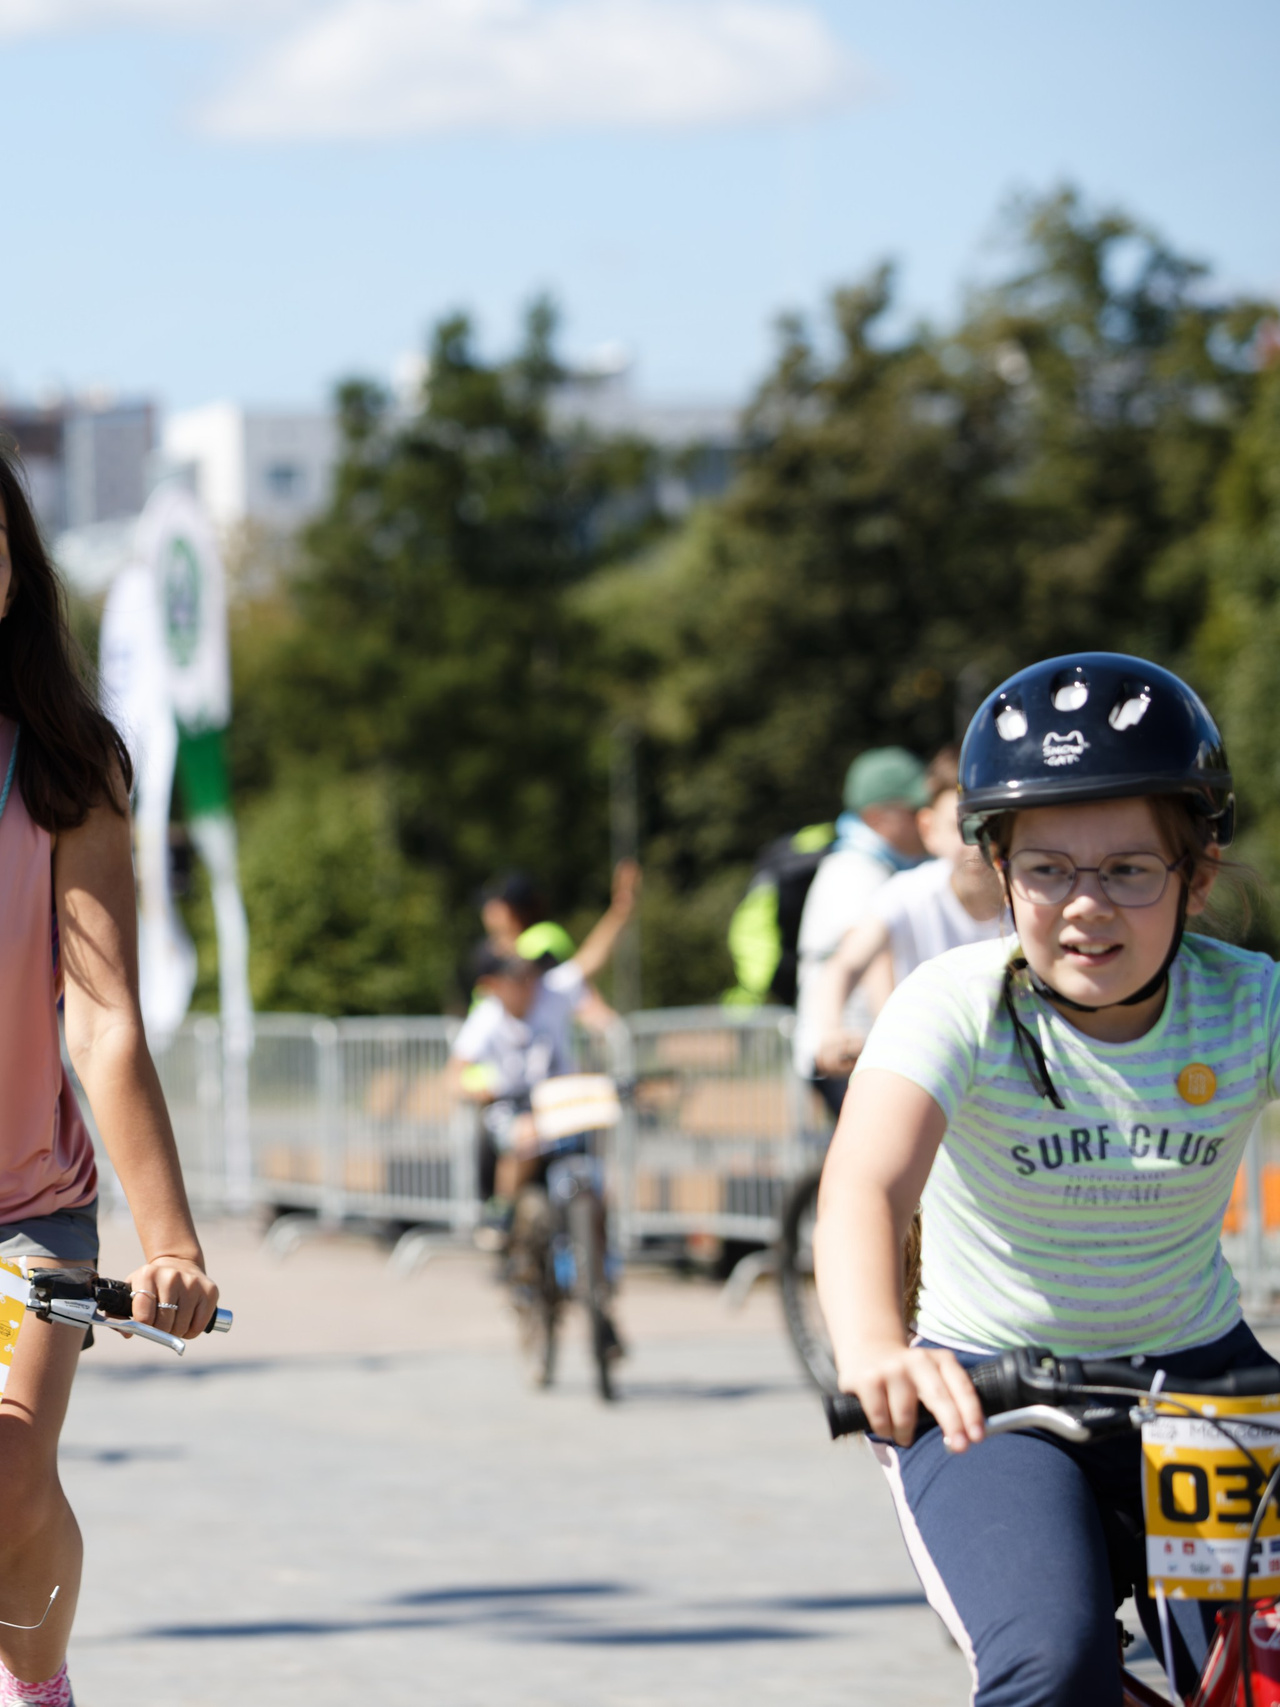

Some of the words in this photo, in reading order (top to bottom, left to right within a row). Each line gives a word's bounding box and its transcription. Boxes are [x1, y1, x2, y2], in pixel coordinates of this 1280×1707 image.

[1011, 1124, 1110, 1176] SURF
[1129, 1124, 1224, 1166] CLUB
[1063, 1182, 1162, 1206] HAWAII
[1159, 1463, 1280, 1523] 03
